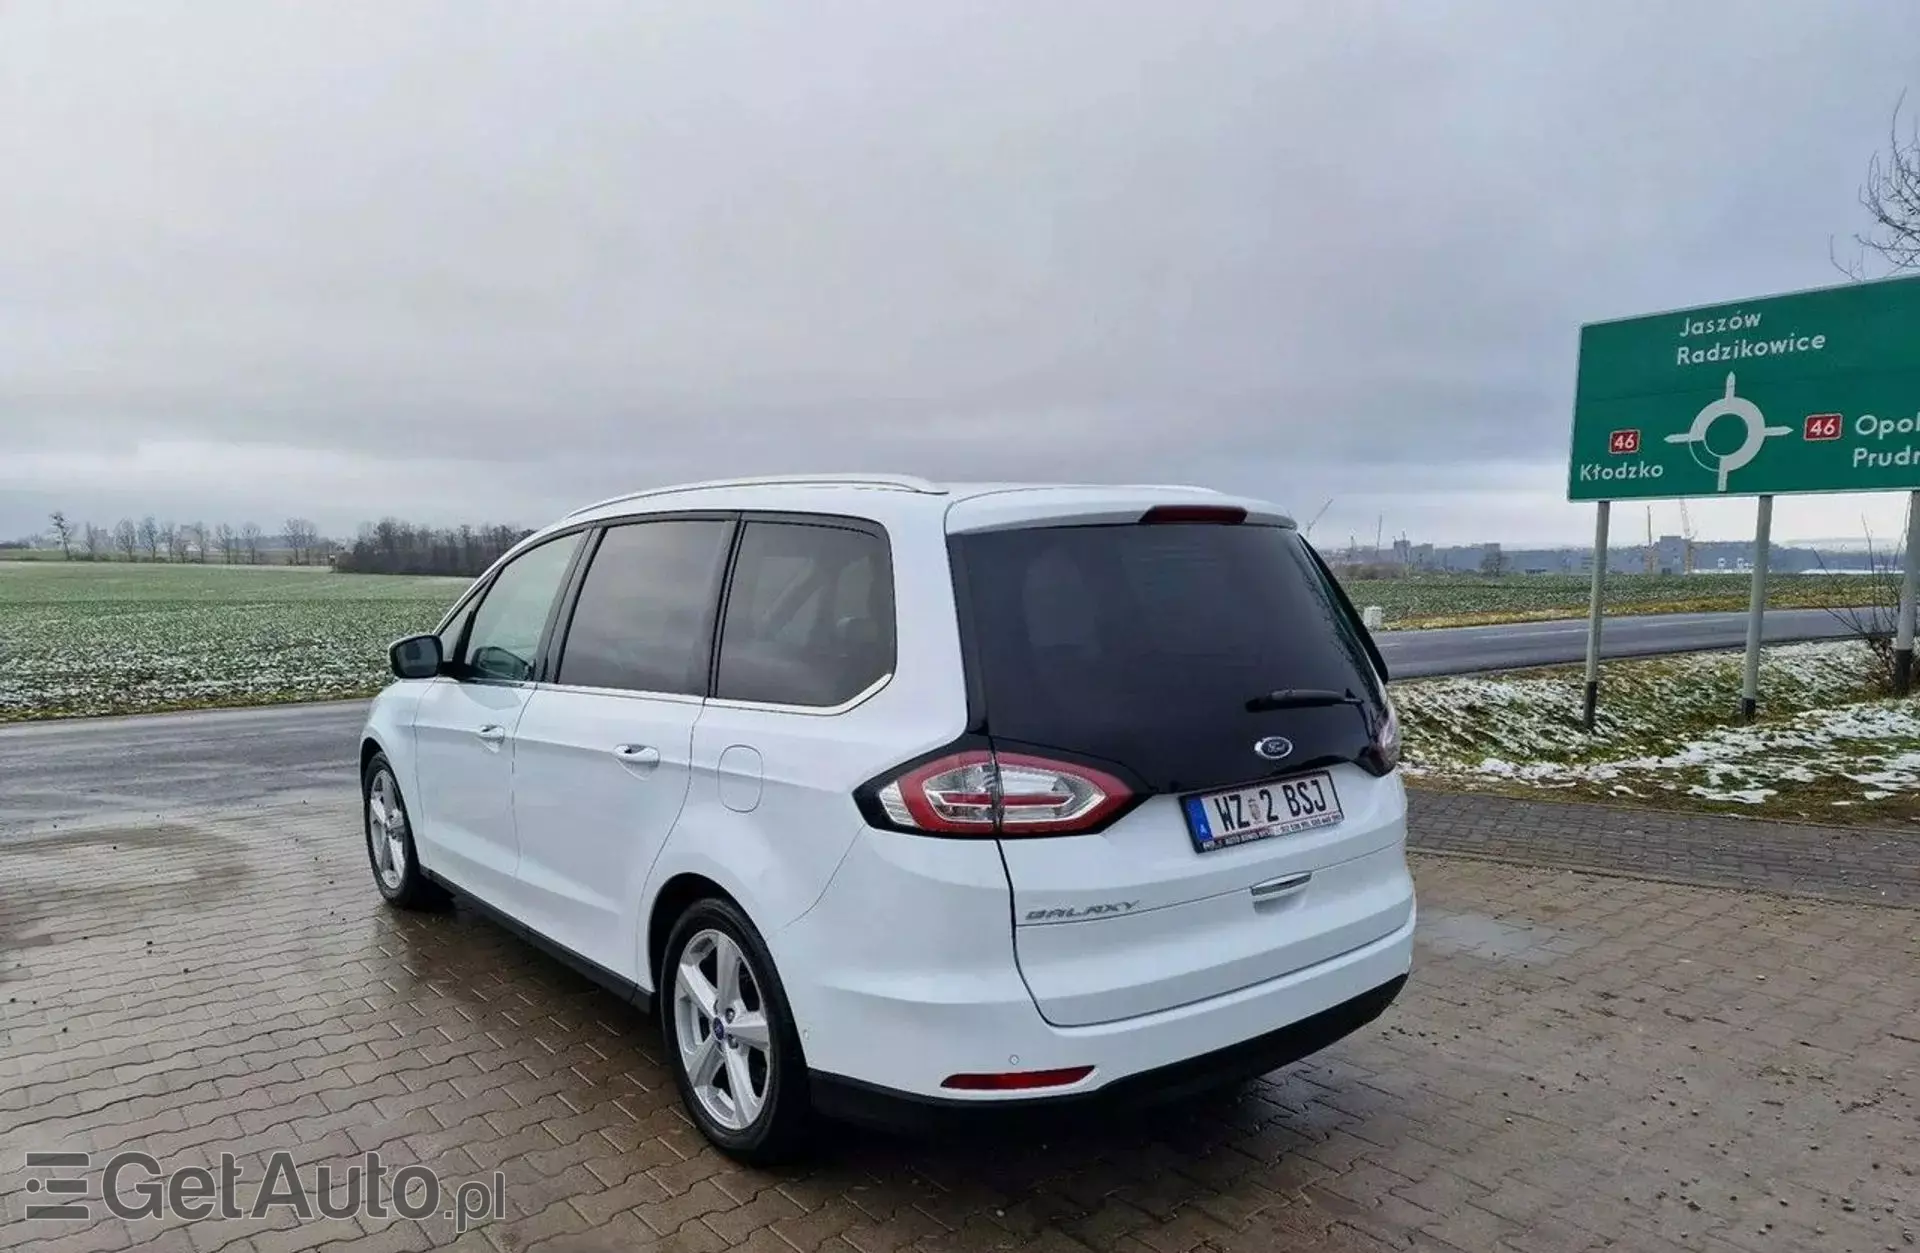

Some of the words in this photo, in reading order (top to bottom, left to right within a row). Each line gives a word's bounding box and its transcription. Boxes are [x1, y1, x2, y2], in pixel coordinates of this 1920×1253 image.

[1679, 310, 1762, 338] Jaszów
[1676, 331, 1826, 366] Radzikowice
[1810, 418, 1836, 436] 46
[1855, 411, 1920, 441] Opol
[1614, 433, 1635, 450] 46
[1580, 460, 1664, 481] Kłodzko
[1214, 793, 1251, 832] WZ
[1258, 788, 1279, 823] 2
[1282, 779, 1327, 818] BSJ
[1025, 899, 1140, 920] GALAXY
